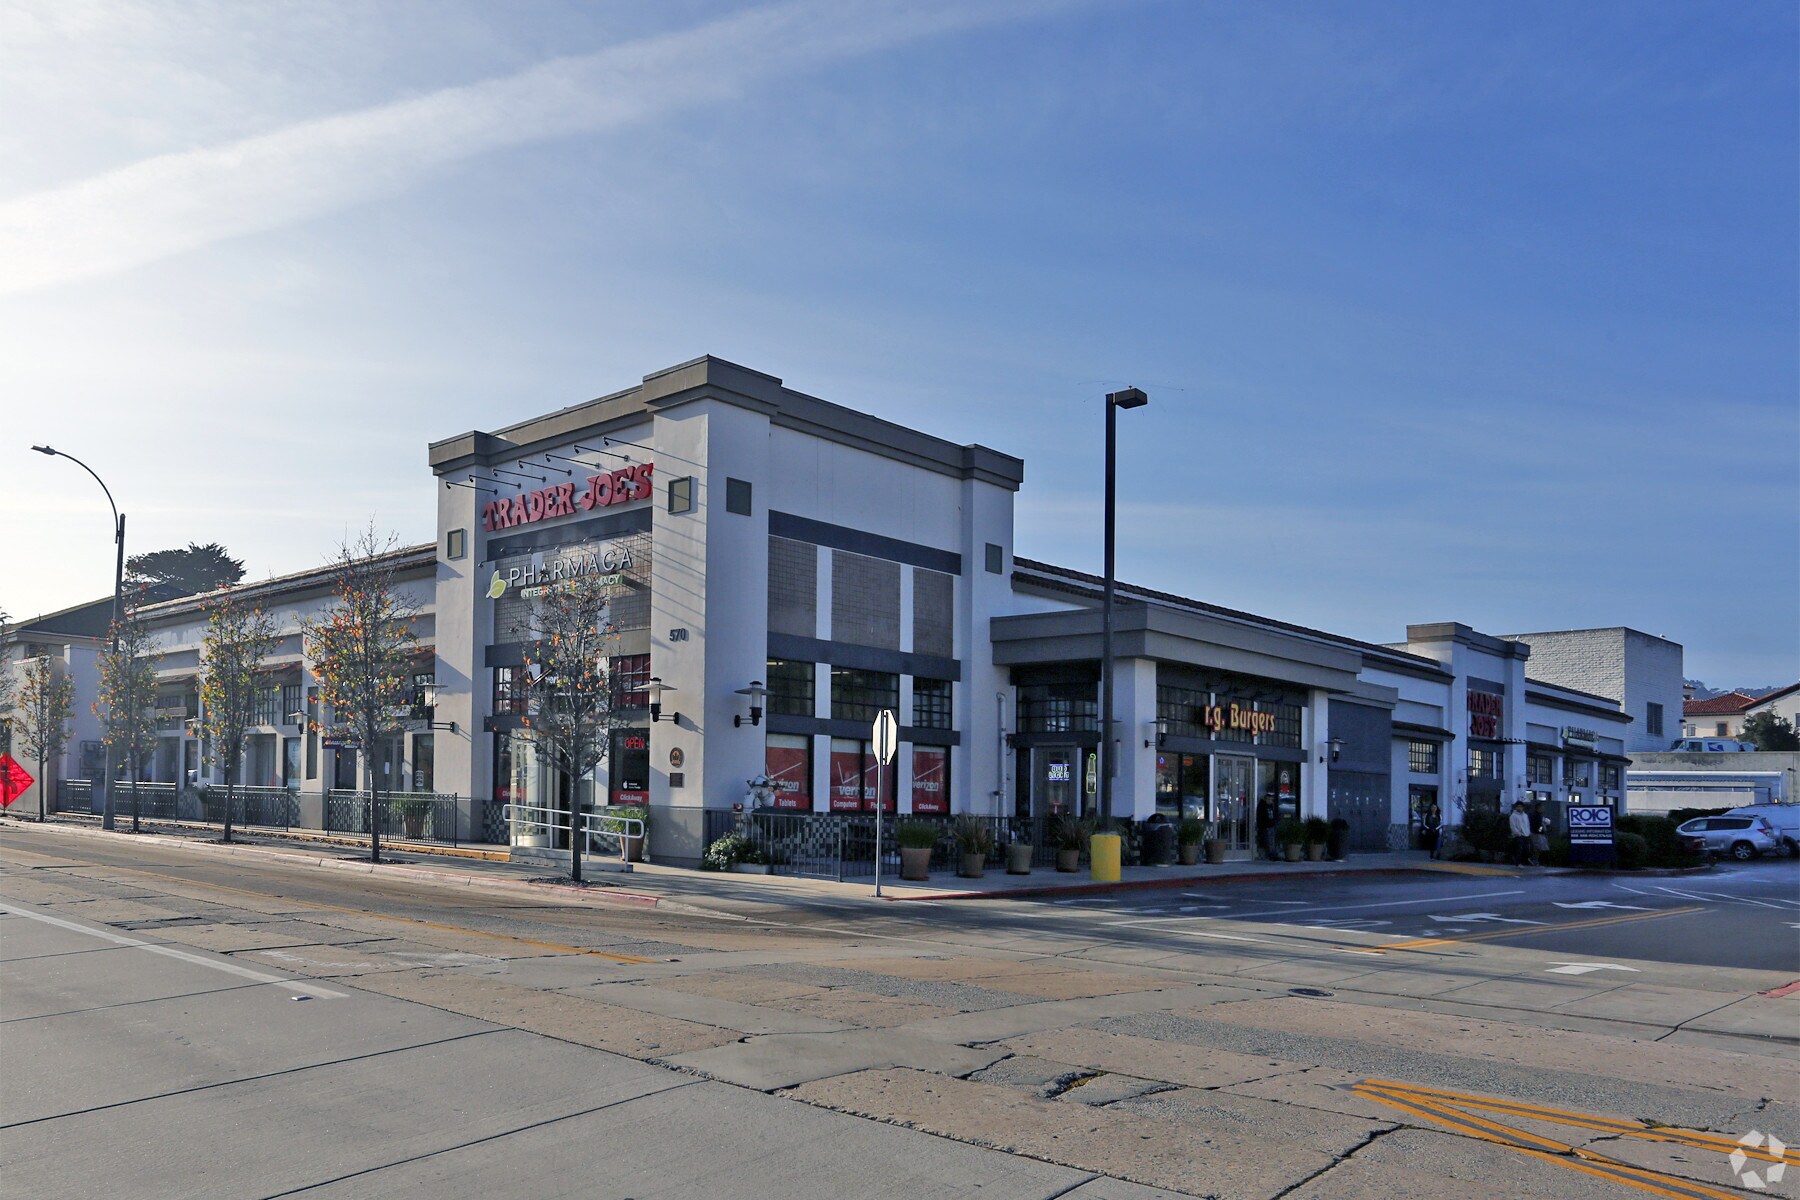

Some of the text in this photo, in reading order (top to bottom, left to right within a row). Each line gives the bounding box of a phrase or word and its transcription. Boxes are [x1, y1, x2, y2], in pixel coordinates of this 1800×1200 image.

[482, 463, 653, 532] TRADER JOE'S
[508, 547, 632, 587] PHARMACA
[669, 628, 687, 642] 570
[1204, 703, 1275, 735] r.g. Burgers
[624, 737, 645, 749] OPEN
[912, 779, 939, 792] verizon
[778, 799, 797, 807] Tablets
[833, 800, 858, 808] Computers
[1570, 808, 1609, 822] ROIC
